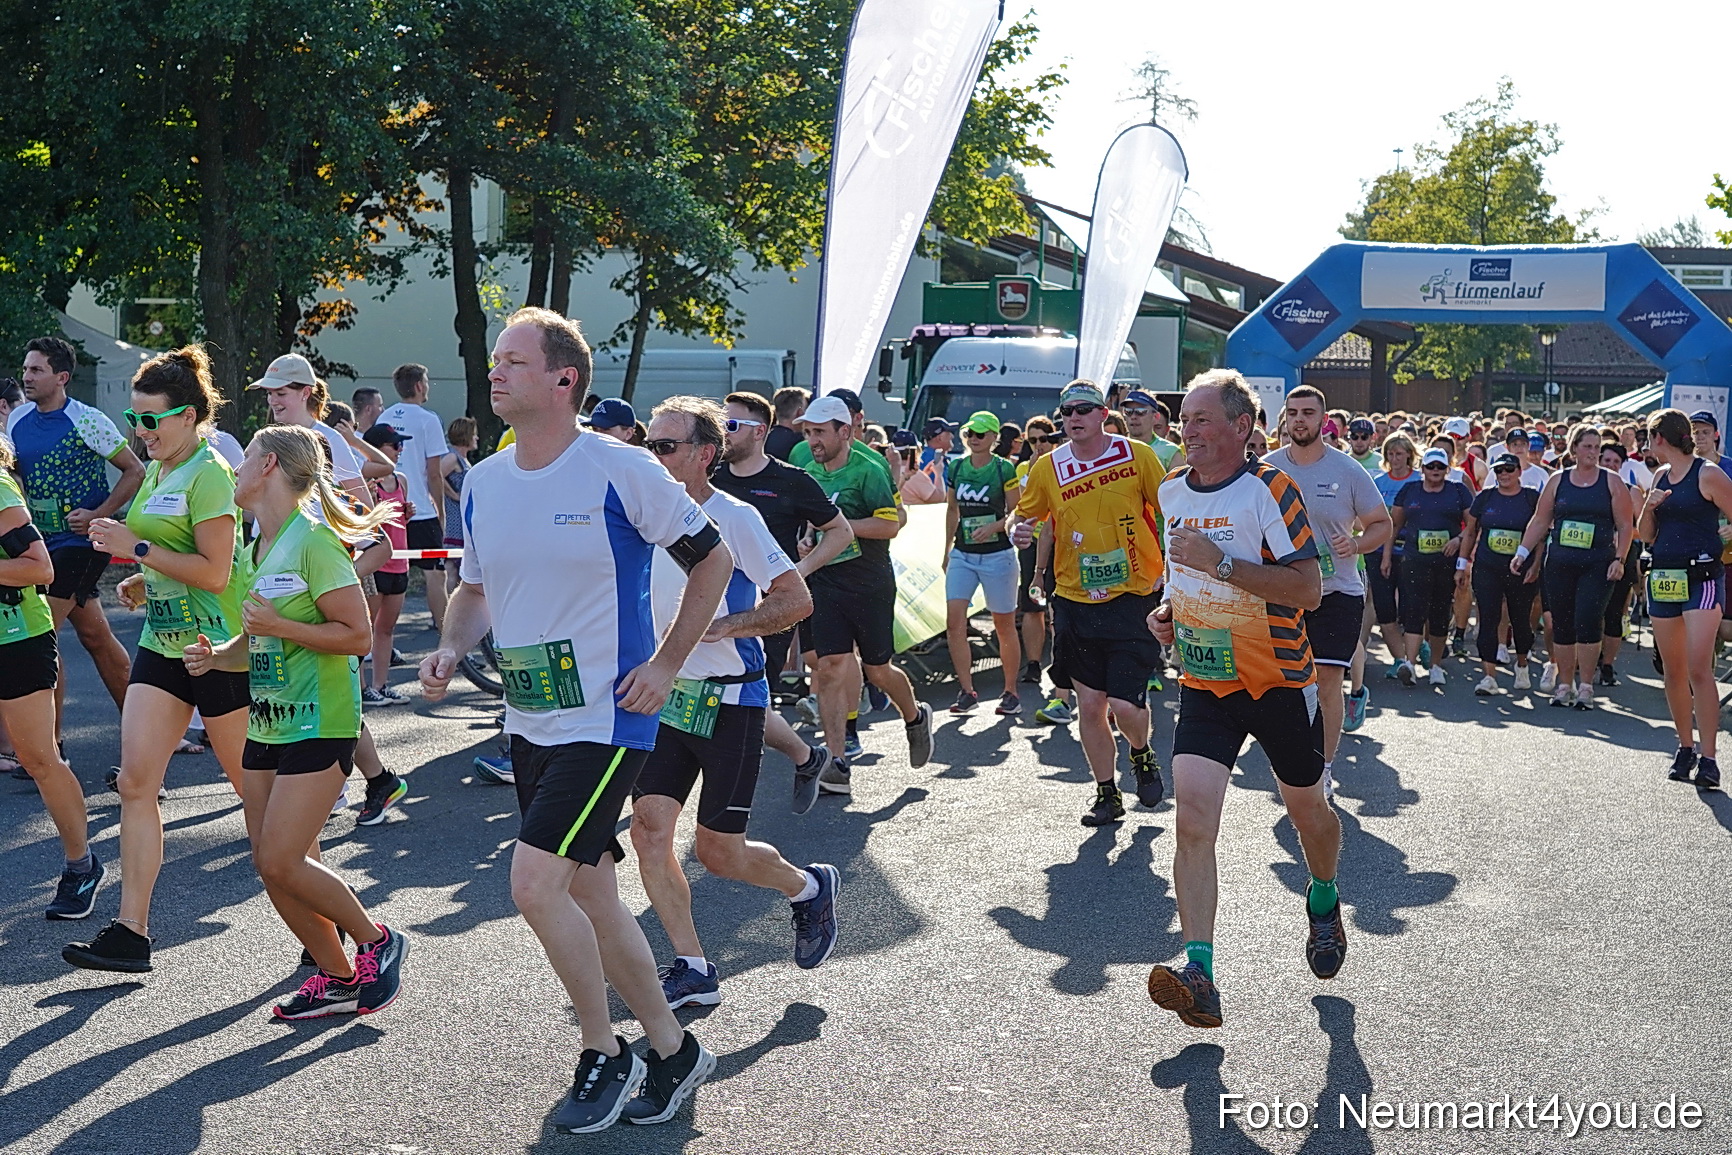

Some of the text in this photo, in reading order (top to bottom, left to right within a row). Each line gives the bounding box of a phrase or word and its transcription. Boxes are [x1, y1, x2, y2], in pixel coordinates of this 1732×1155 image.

[918, 6, 971, 124] AUTOMOBILE
[1455, 281, 1546, 299] firmenlauf
[1281, 305, 1330, 319] Fischer
[1061, 466, 1138, 502] MAX BÖGL
[1184, 515, 1234, 530] KLEBL
[1425, 538, 1442, 547] 483
[1496, 537, 1513, 547] 492
[1567, 529, 1585, 540] 491
[1087, 563, 1122, 579] 1584
[1658, 580, 1678, 592] 487
[150, 599, 173, 617] 161
[180, 598, 193, 623] 2022
[250, 652, 270, 672] 169
[1186, 643, 1217, 664] 404
[1222, 650, 1233, 674] 2022
[274, 655, 285, 682] 2022
[1203, 664, 1227, 672] Roland
[540, 670, 555, 702] 2022
[515, 691, 546, 700] Christian
[683, 698, 696, 724] 2022
